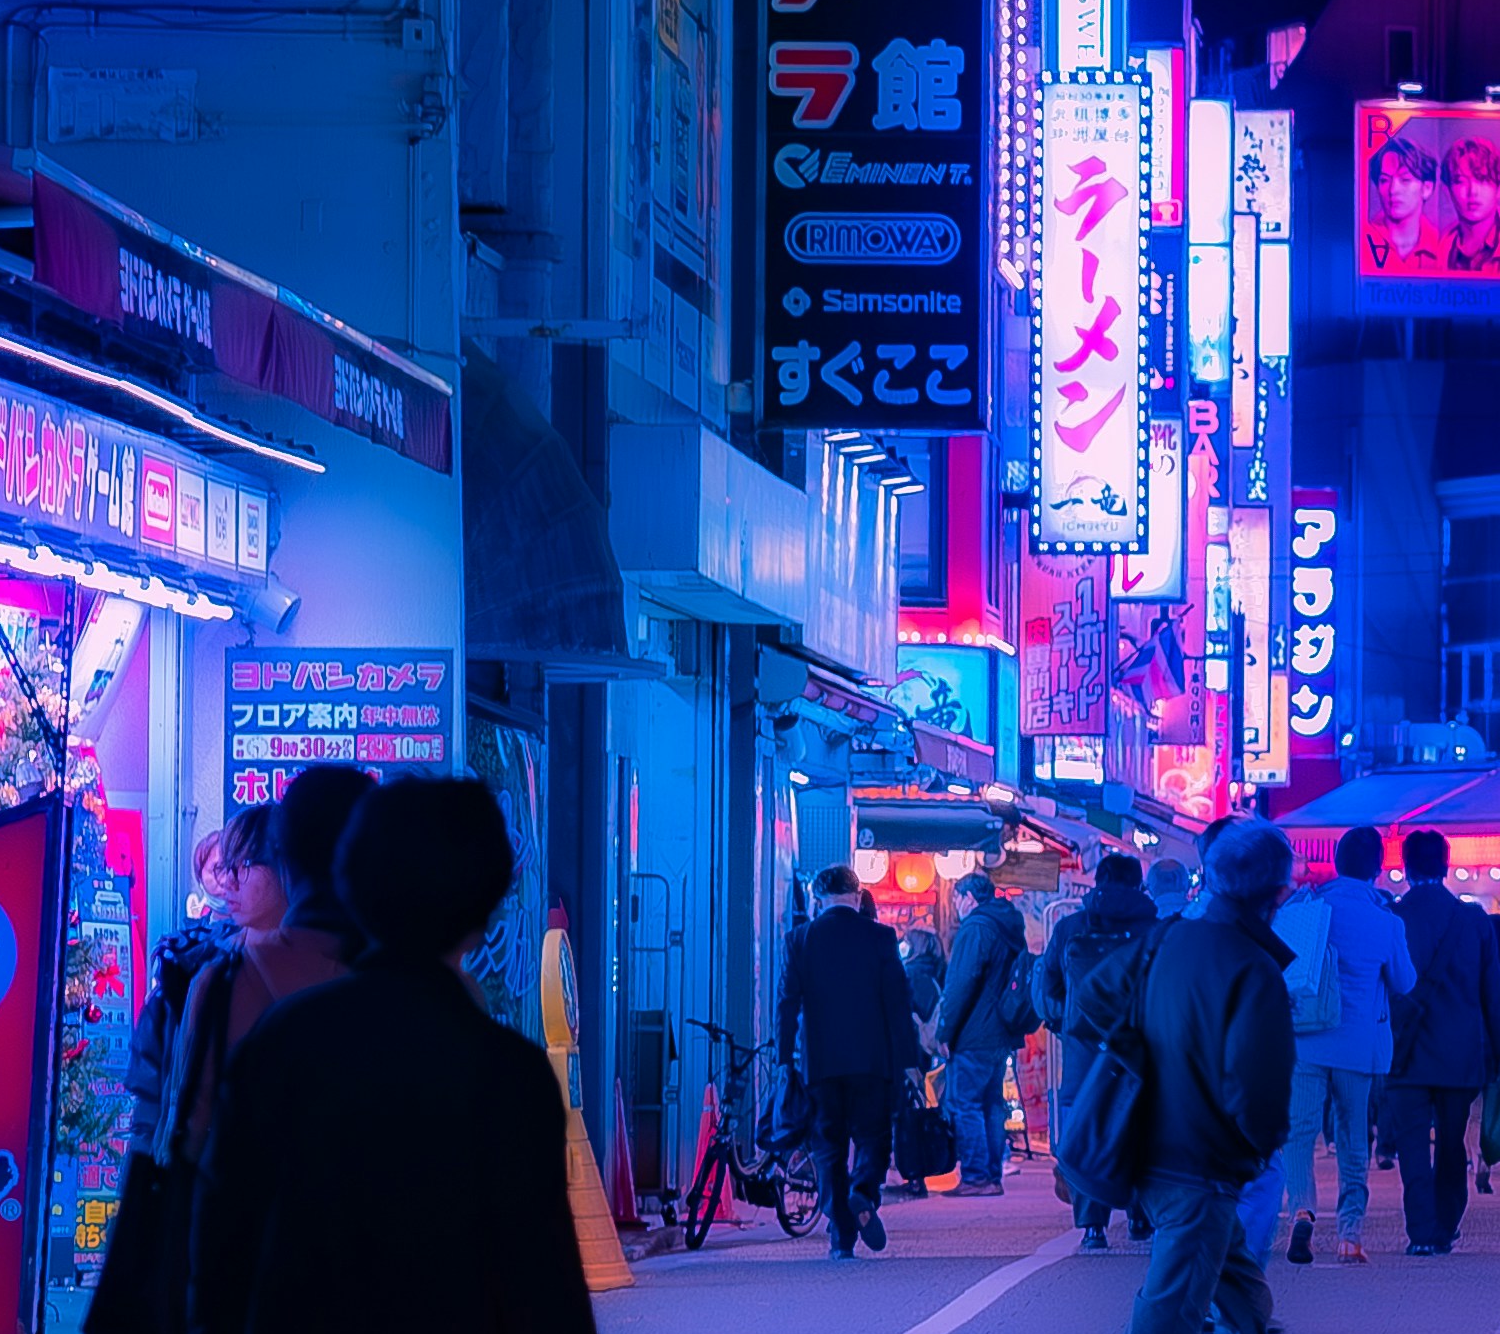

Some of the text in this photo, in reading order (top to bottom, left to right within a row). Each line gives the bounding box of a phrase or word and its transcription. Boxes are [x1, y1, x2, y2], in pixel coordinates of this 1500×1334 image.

[809, 223, 942, 255] RIMOWA
[823, 289, 962, 314] Samsonite
[1054, 155, 1129, 453] ラーメン
[1367, 281, 1425, 306] Travis
[1428, 283, 1490, 309] Japan
[772, 340, 971, 406] すぐここ
[232, 662, 445, 691] ヨドバシカメラ
[232, 703, 357, 728] フロア案内
